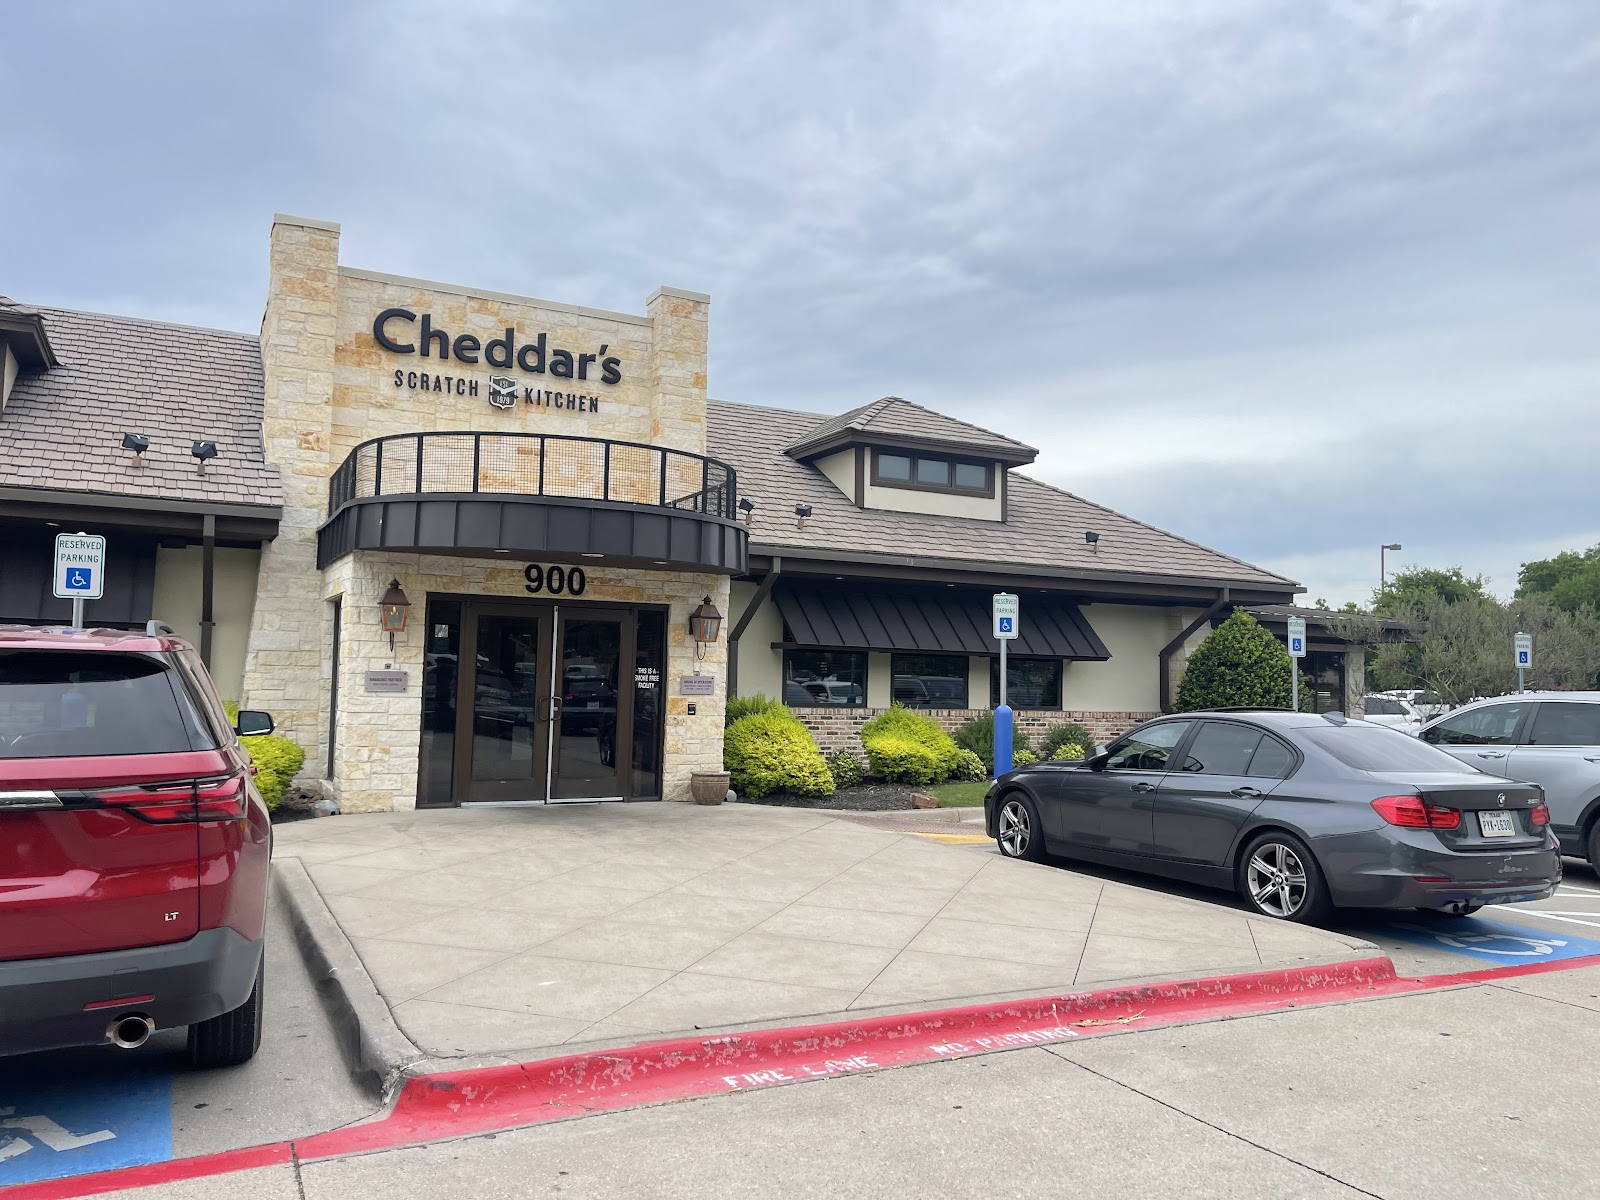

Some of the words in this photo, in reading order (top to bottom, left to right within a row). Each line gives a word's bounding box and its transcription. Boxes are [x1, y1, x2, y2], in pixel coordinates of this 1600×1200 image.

[373, 307, 622, 385] Cheddar's
[394, 369, 479, 397] SCRATCH
[524, 387, 599, 413] KITCHEN
[497, 395, 510, 404] 1979
[59, 539, 102, 550] RESERVED
[60, 553, 99, 563] PARKING
[524, 563, 586, 596] 900
[164, 911, 180, 921] LT
[722, 1067, 794, 1088] FIRE
[802, 1055, 879, 1076] LANE
[975, 1027, 1079, 1050] PARKING
